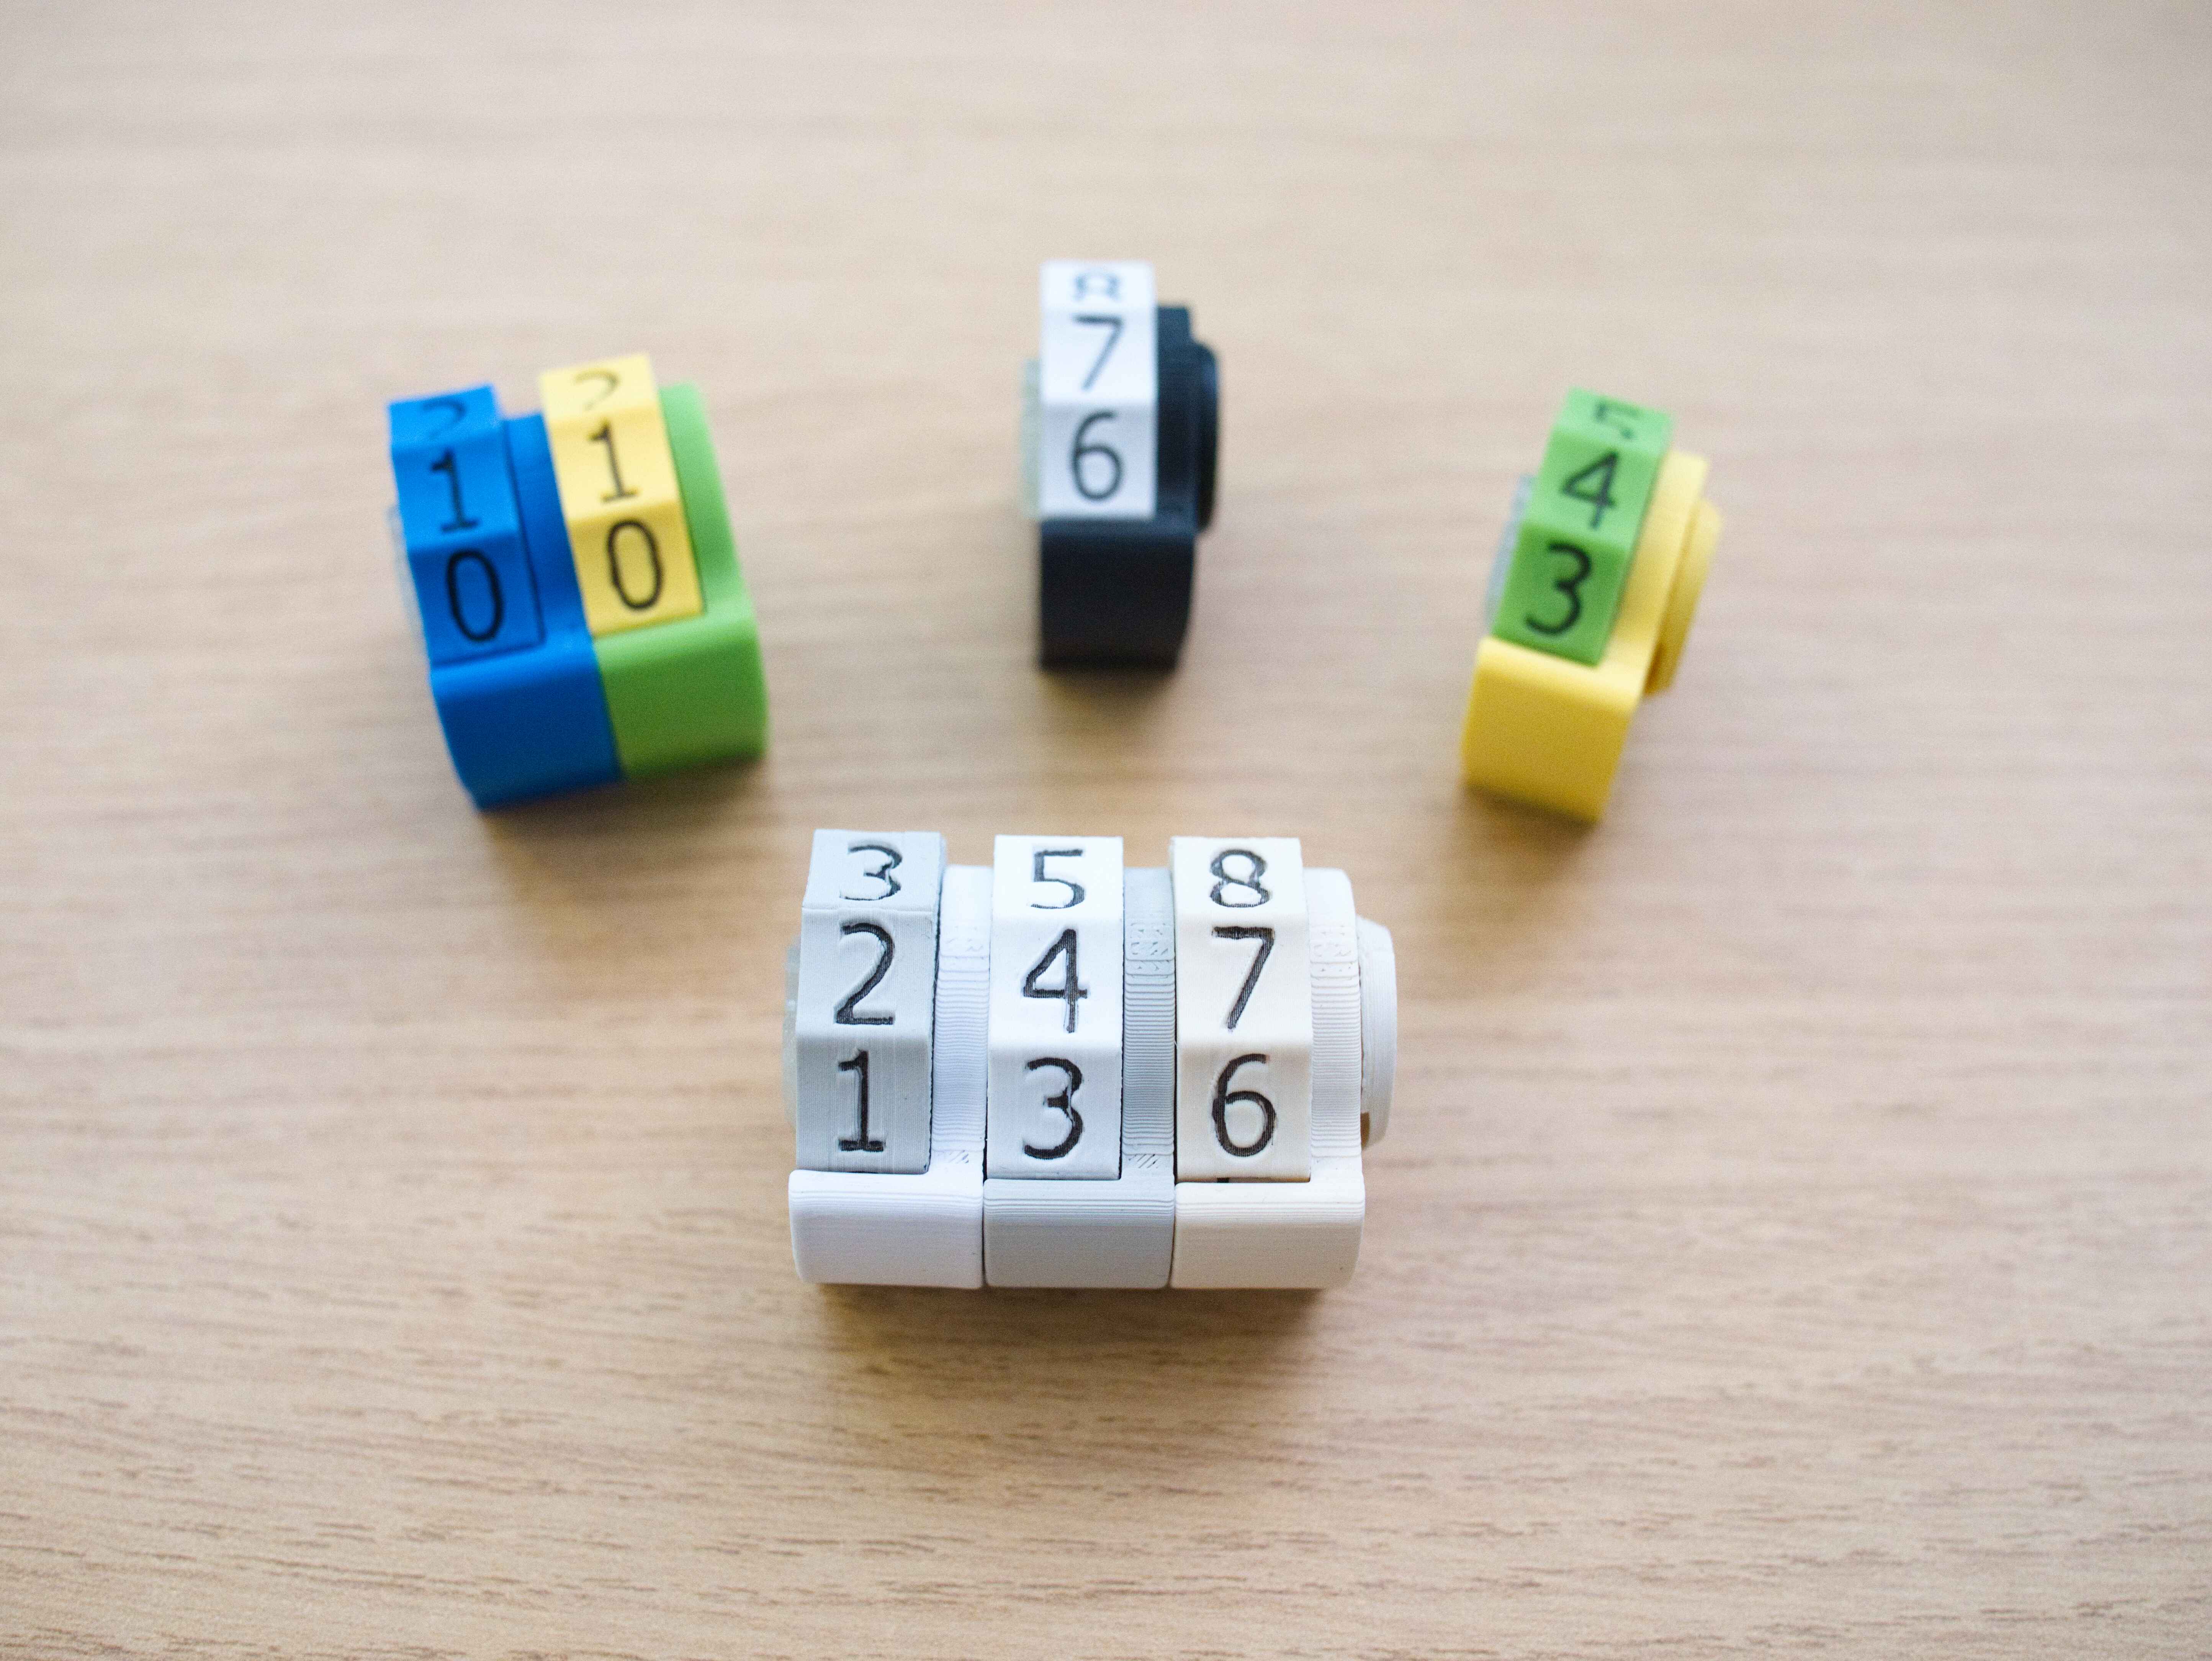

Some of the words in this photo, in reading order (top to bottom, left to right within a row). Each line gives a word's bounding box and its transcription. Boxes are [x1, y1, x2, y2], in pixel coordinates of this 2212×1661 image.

[1073, 313, 1124, 391] 7
[432, 450, 478, 533] 1
[588, 419, 638, 504] 1
[1070, 410, 1122, 500] 6
[1562, 450, 1618, 530] 4
[447, 550, 504, 642] 0
[606, 519, 664, 611] 0
[1523, 542, 1592, 636] 3
[840, 844, 903, 900] 3
[1029, 849, 1085, 909] 5
[1209, 849, 1271, 908] 8
[834, 922, 896, 1025] 2
[1022, 929, 1088, 1033] 4
[1211, 927, 1275, 1031] 7
[837, 1049, 887, 1152] 1
[1024, 1057, 1084, 1160] 3
[1212, 1054, 1276, 1157] 6
